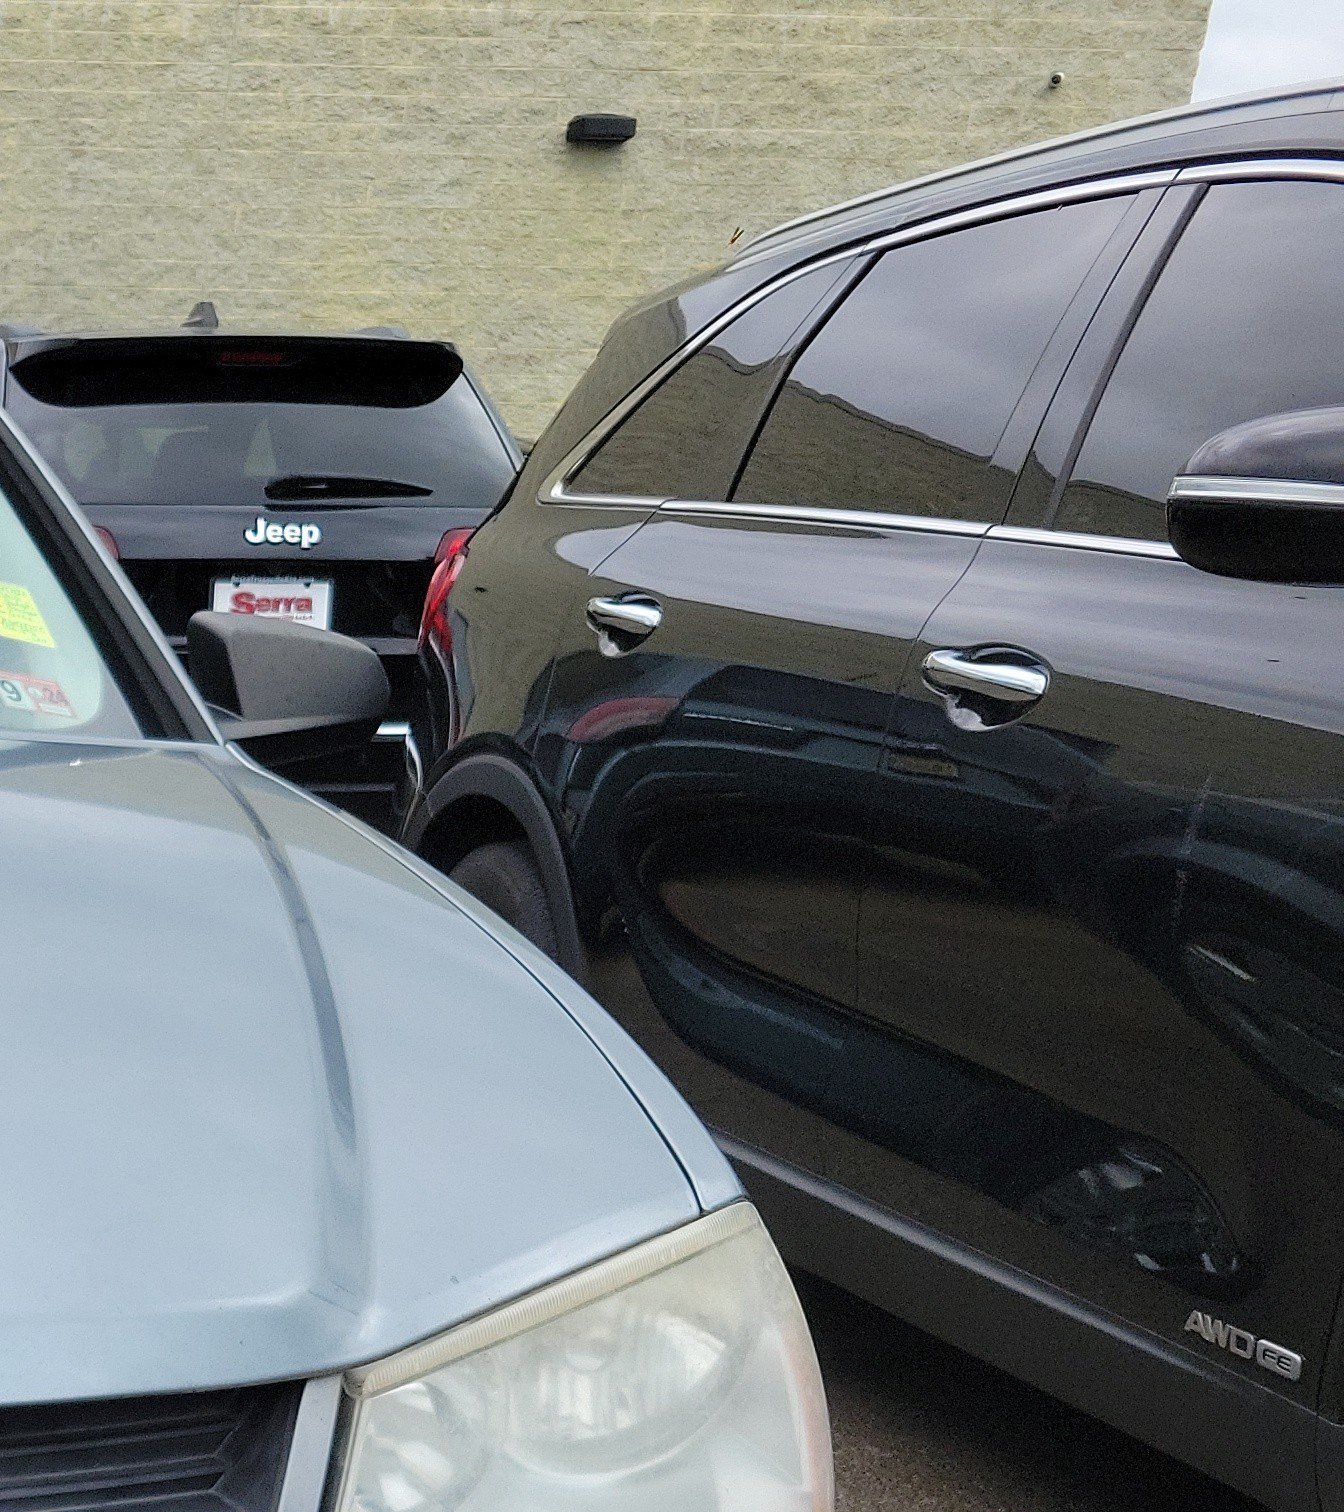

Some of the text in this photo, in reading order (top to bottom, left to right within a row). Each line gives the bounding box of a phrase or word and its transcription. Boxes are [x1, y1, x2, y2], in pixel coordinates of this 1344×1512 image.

[244, 517, 321, 549] Jeep
[231, 592, 312, 614] Serra
[0, 680, 22, 701] 9
[1184, 1310, 1254, 1359] AWD
